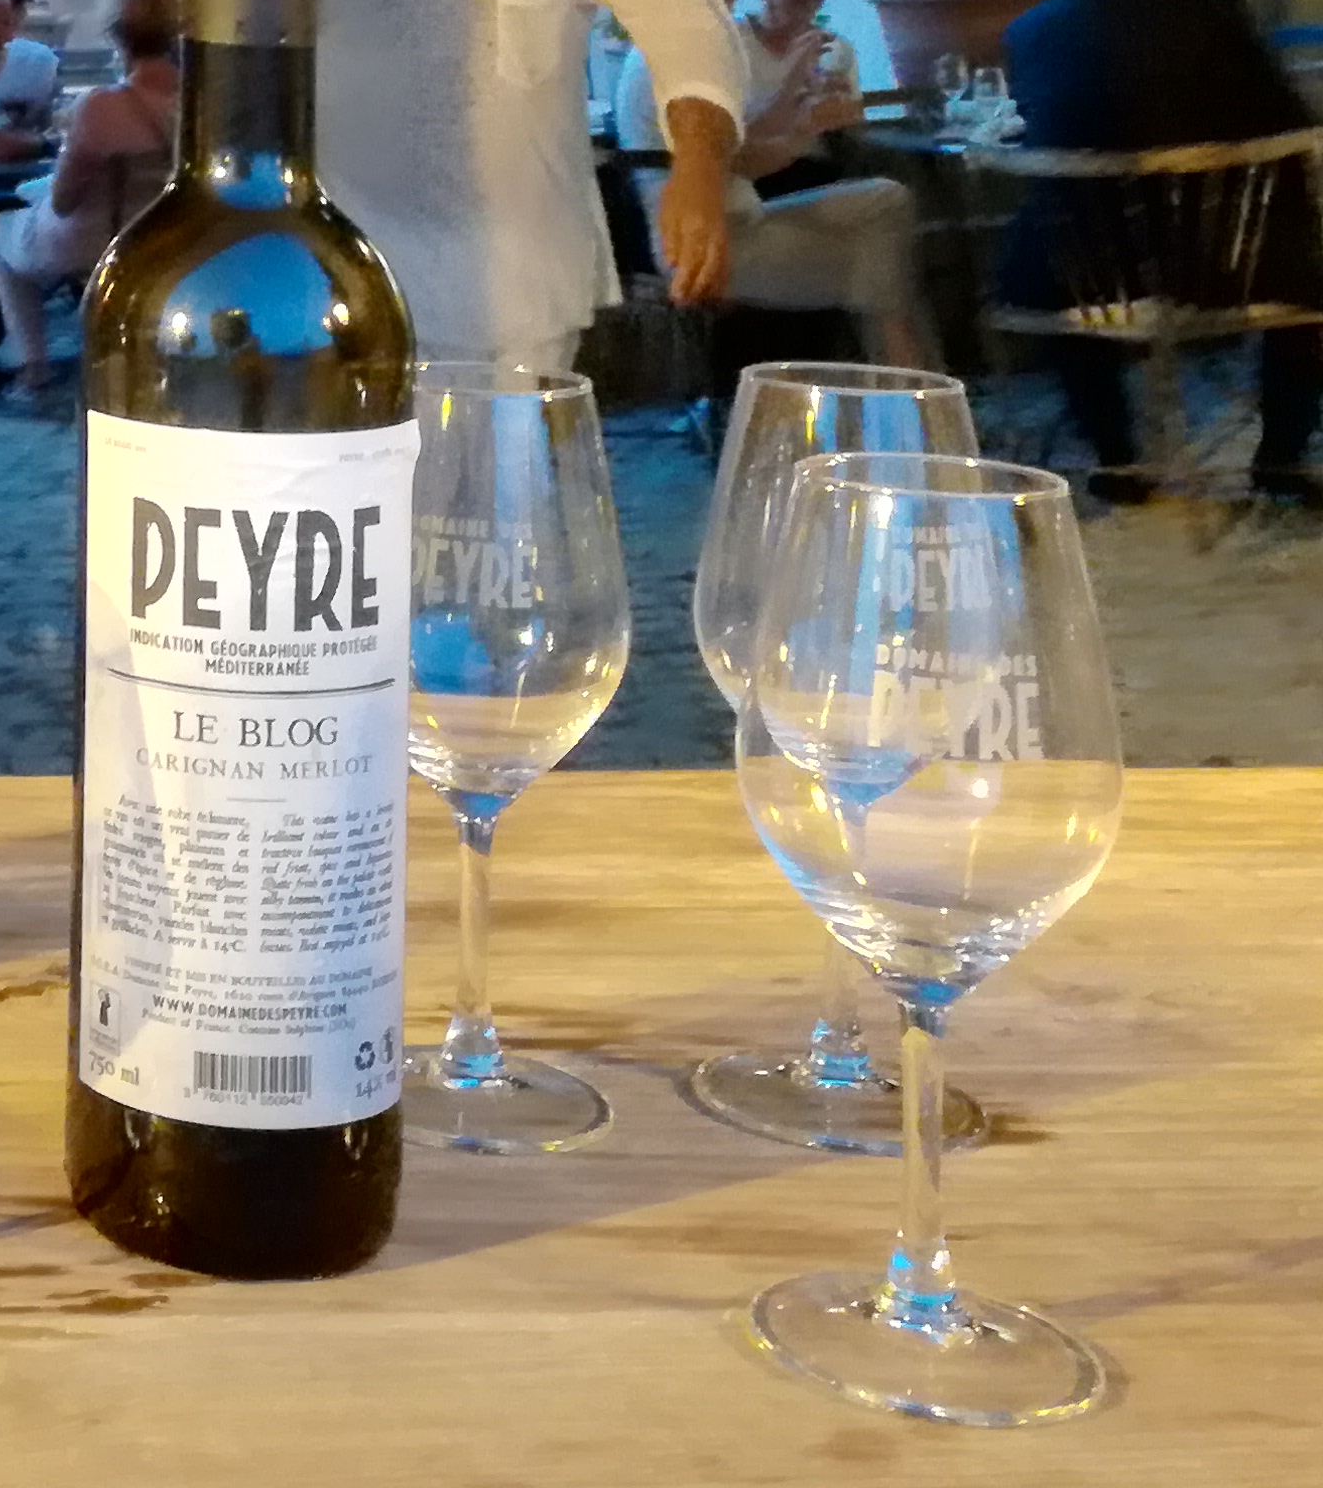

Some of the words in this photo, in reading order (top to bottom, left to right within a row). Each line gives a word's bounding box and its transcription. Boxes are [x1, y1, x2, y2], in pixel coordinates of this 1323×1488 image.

[131, 496, 381, 632] PEYRE
[129, 627, 205, 655] INDICATION
[210, 638, 317, 659] GÉOGRAPHIQUE
[205, 658, 310, 677] MÉDITERRANÉE
[173, 710, 219, 744] LE
[238, 716, 339, 748] BLOG
[136, 747, 264, 780] CARIGNAN
[279, 753, 373, 781] MERLOT
[88, 1050, 116, 1077] 750
